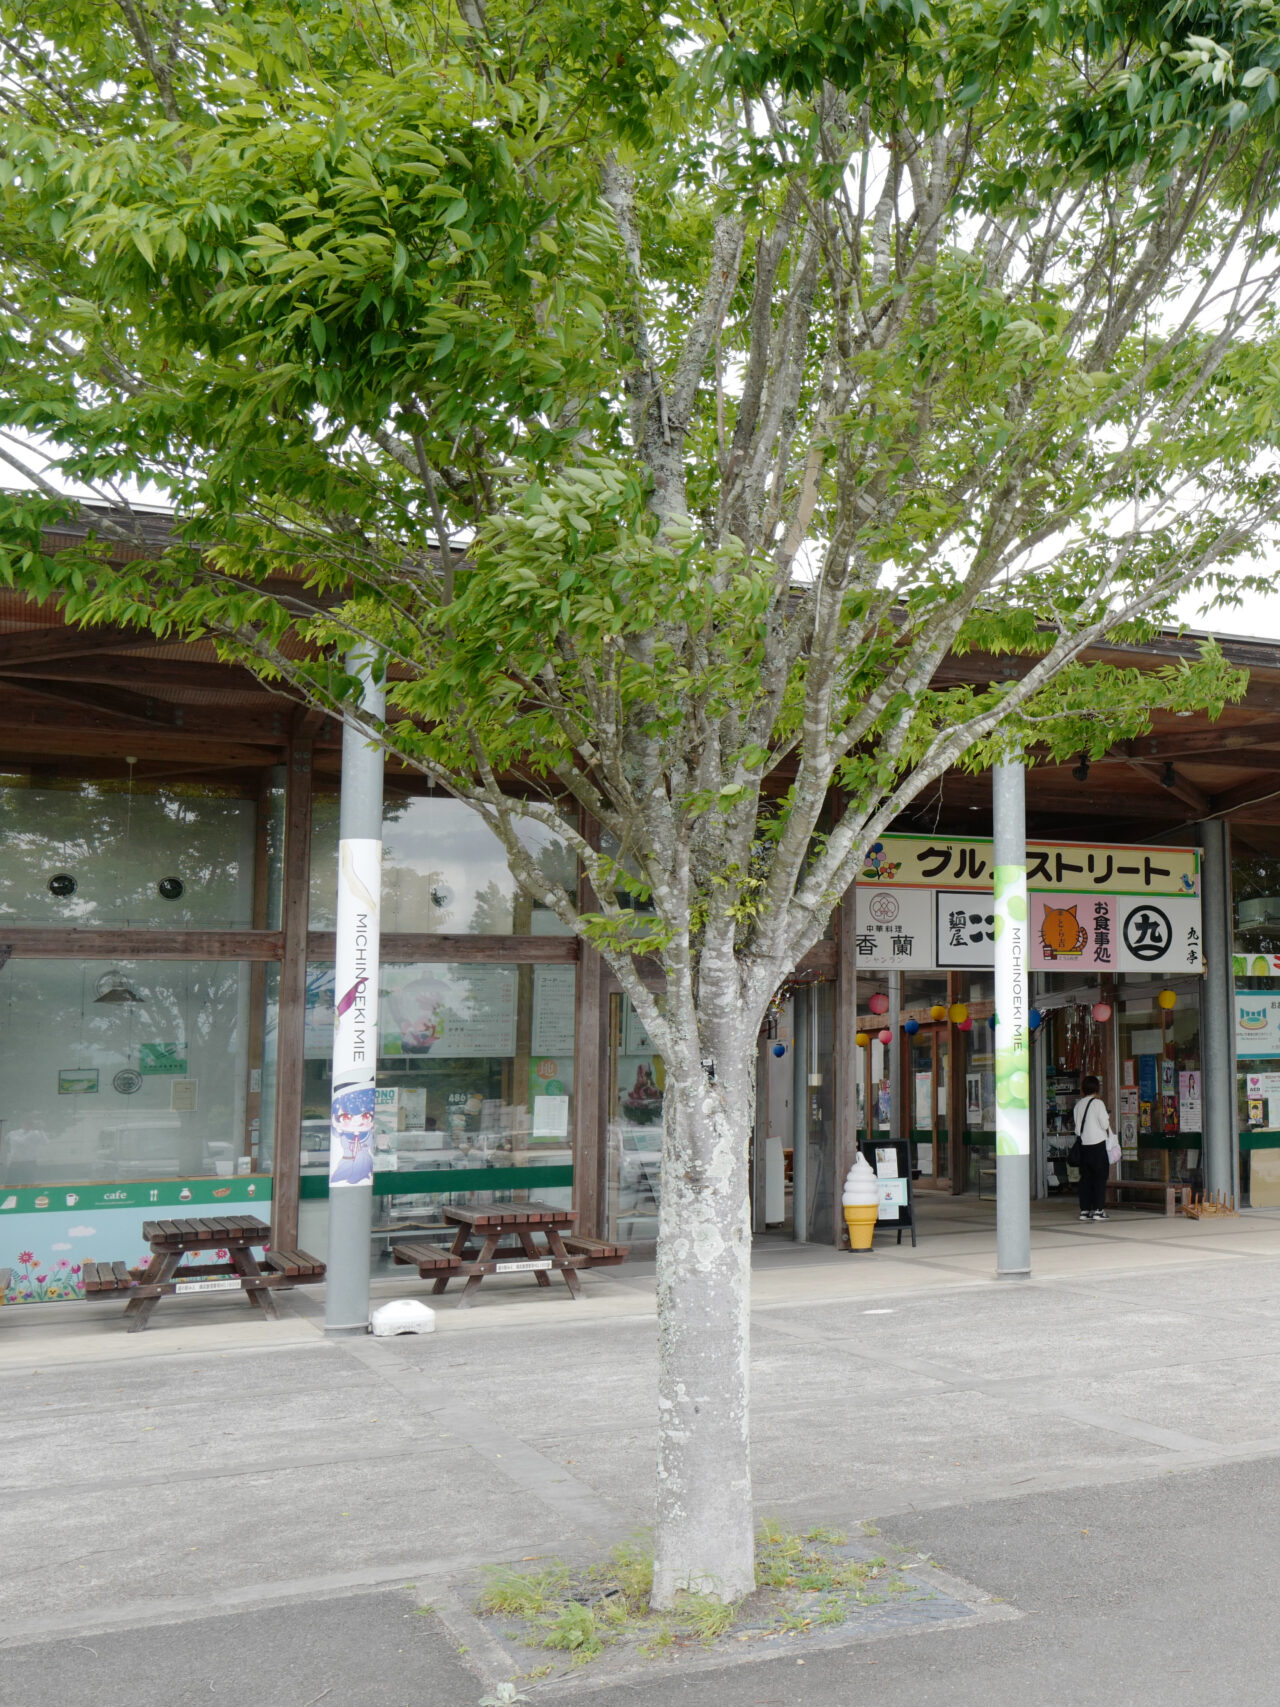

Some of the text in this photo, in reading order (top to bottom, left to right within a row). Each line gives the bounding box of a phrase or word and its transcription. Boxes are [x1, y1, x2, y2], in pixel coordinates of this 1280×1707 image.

[916, 845, 1171, 886] グルストリート
[856, 934, 915, 957] 香蘭
[866, 925, 903, 933] 中華料理
[1093, 902, 1112, 964] お食事処
[1186, 926, 1200, 965] 九一亭
[353, 913, 368, 1062] MICHINOEKI MIE
[1012, 927, 1023, 1052] MICHINOEKI MIE
[103, 1190, 128, 1200] cafe
